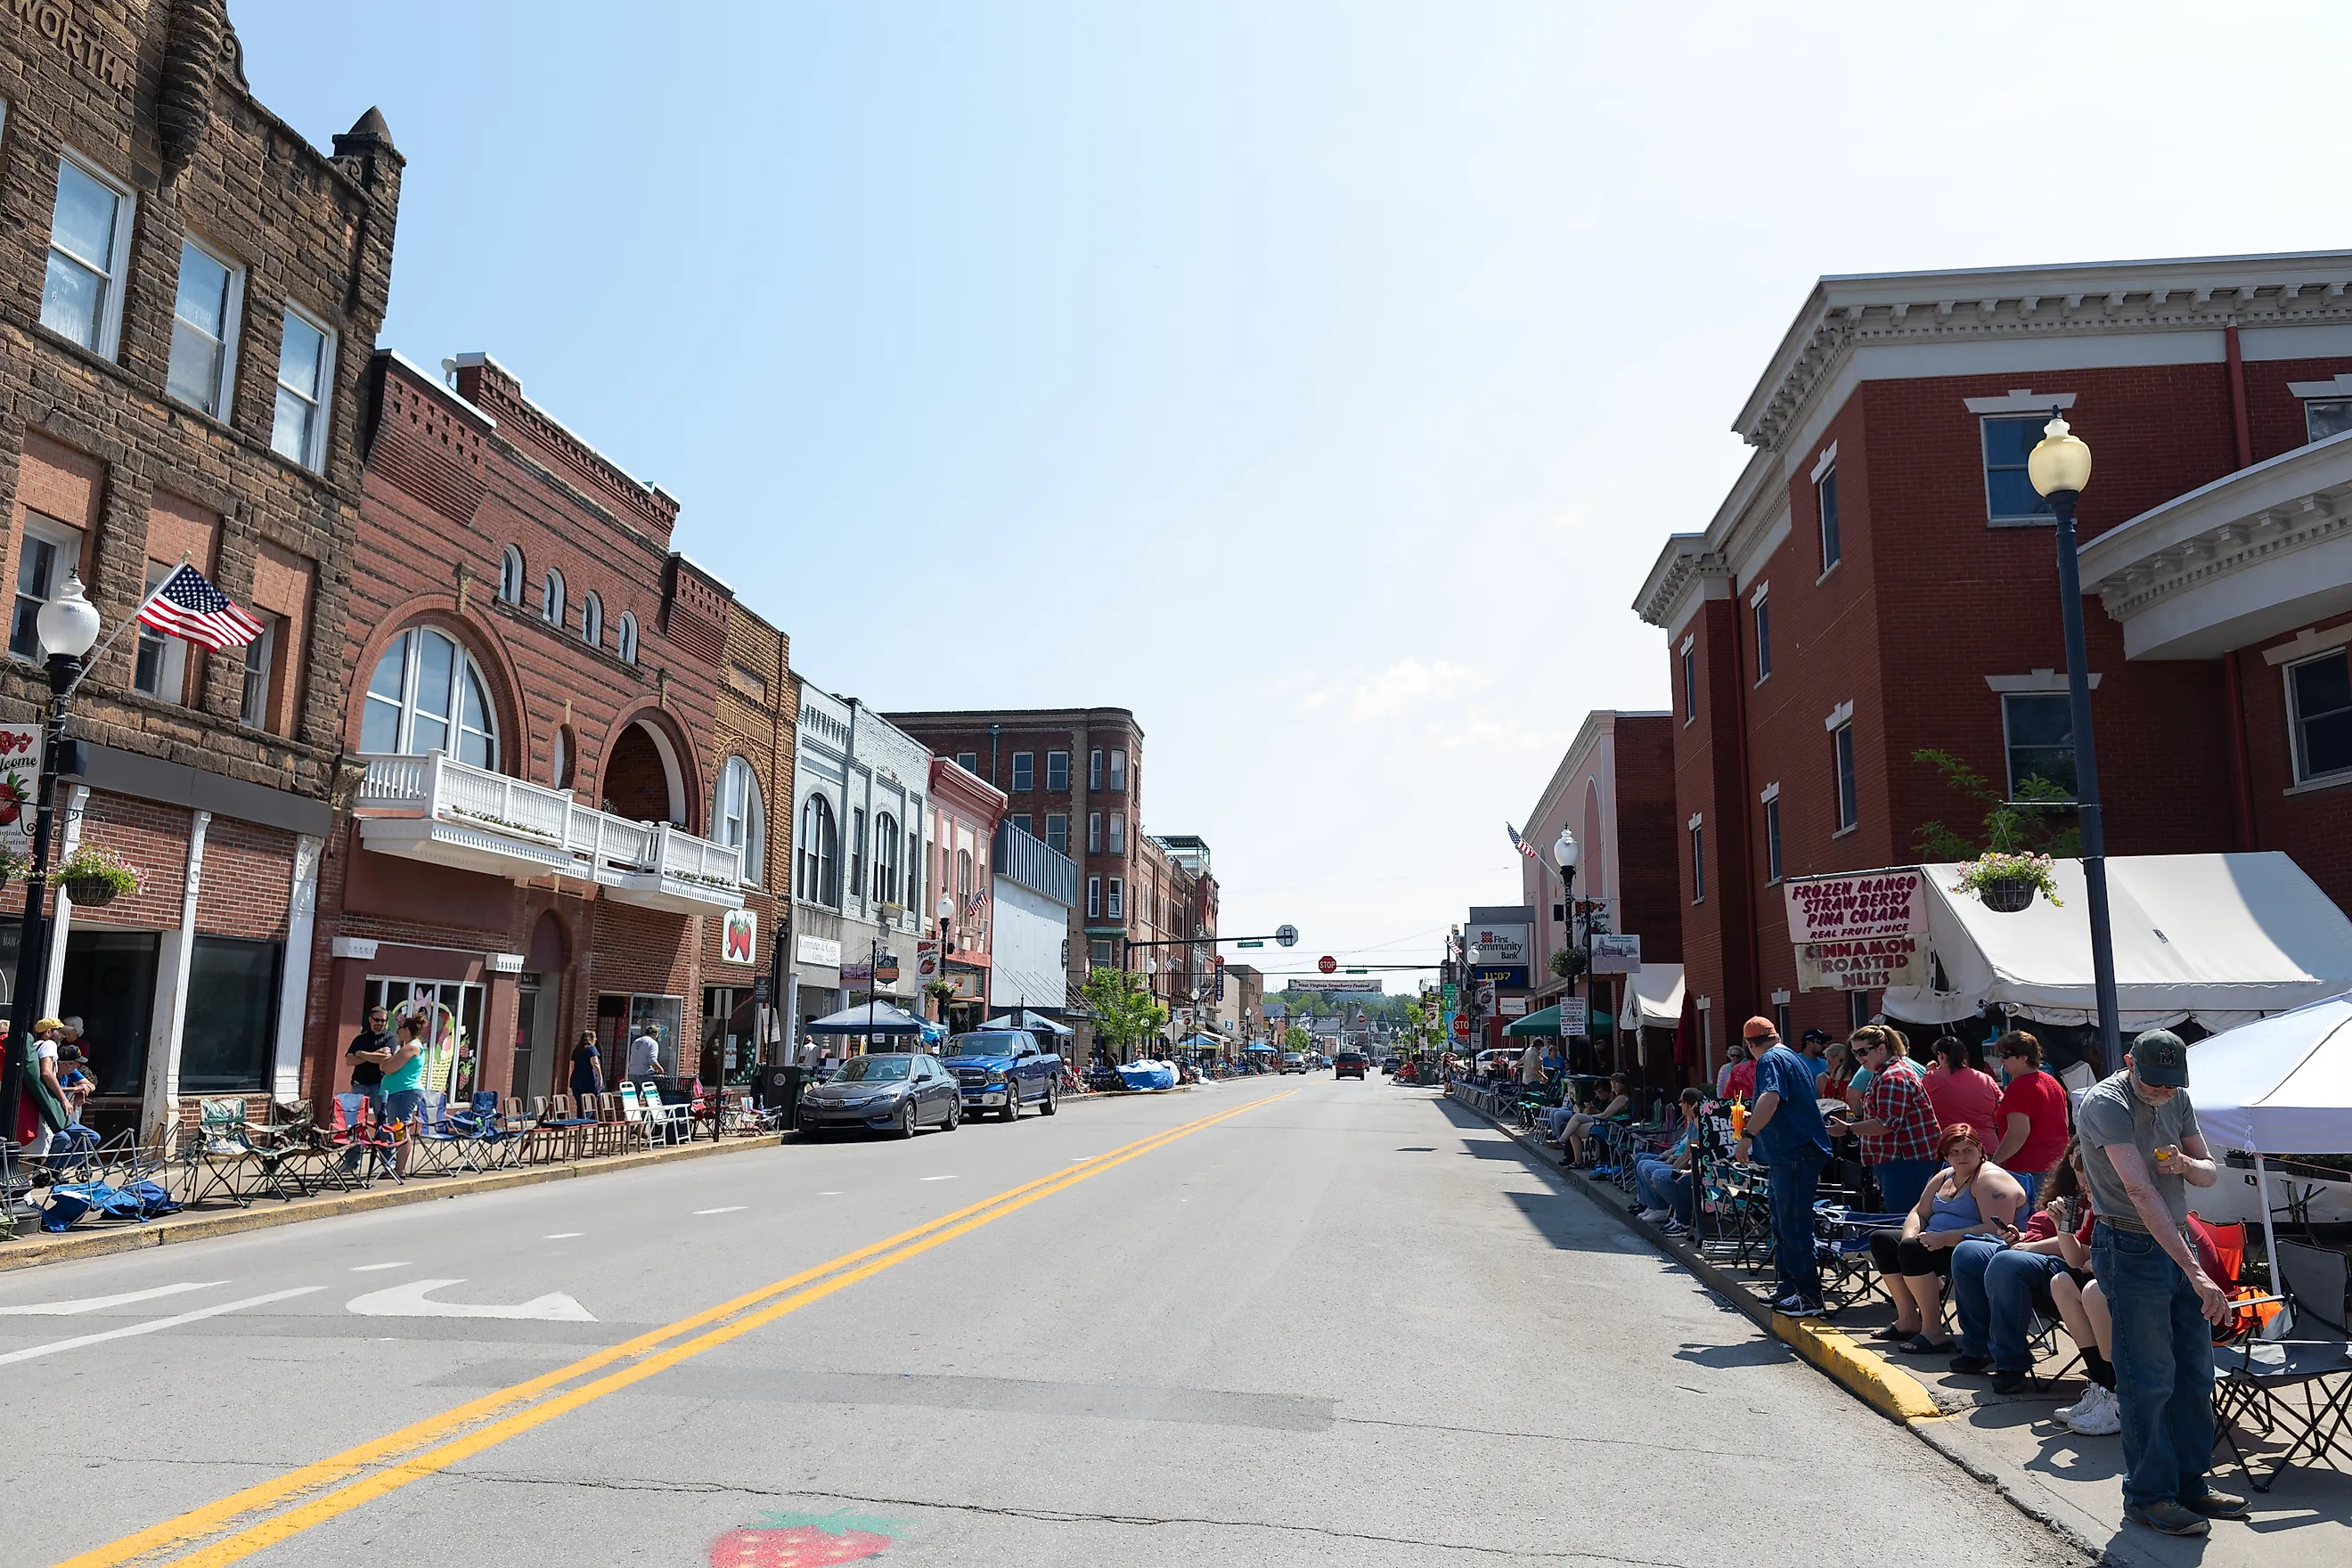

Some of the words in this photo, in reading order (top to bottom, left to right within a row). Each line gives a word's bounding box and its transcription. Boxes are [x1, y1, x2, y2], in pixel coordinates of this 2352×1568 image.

[1793, 881, 1853, 901] FROZEN
[1858, 876, 1917, 894] MANGO
[1802, 891, 1912, 914] STRAWBERRY
[1806, 911, 1844, 928] PINA
[1850, 905, 1910, 924] COLADA
[1810, 929, 1837, 940] REAL
[1841, 927, 1874, 936] FRUIT
[1876, 923, 1909, 934] JUICE
[1471, 941, 1523, 954] Community
[1501, 951, 1518, 960] Bank
[1820, 954, 1908, 974] ROASTED
[1484, 972, 1511, 980] 11:07
[1841, 971, 1891, 987] NUTS
[1455, 1021, 1469, 1029] STO
